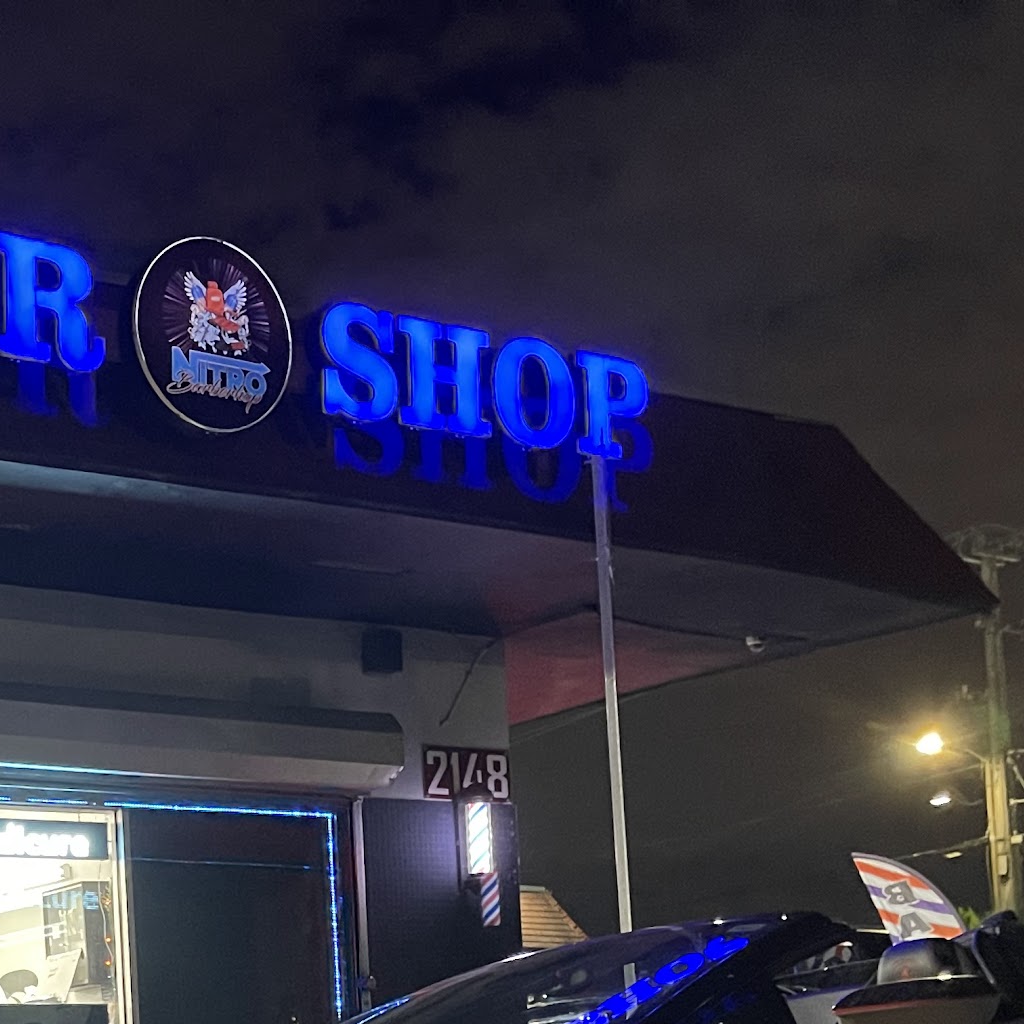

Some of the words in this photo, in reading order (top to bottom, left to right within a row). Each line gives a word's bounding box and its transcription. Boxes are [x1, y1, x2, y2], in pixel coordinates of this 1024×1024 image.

[172, 346, 271, 398] NITRO
[321, 301, 651, 460] SHOP
[426, 750, 509, 799] 2148
